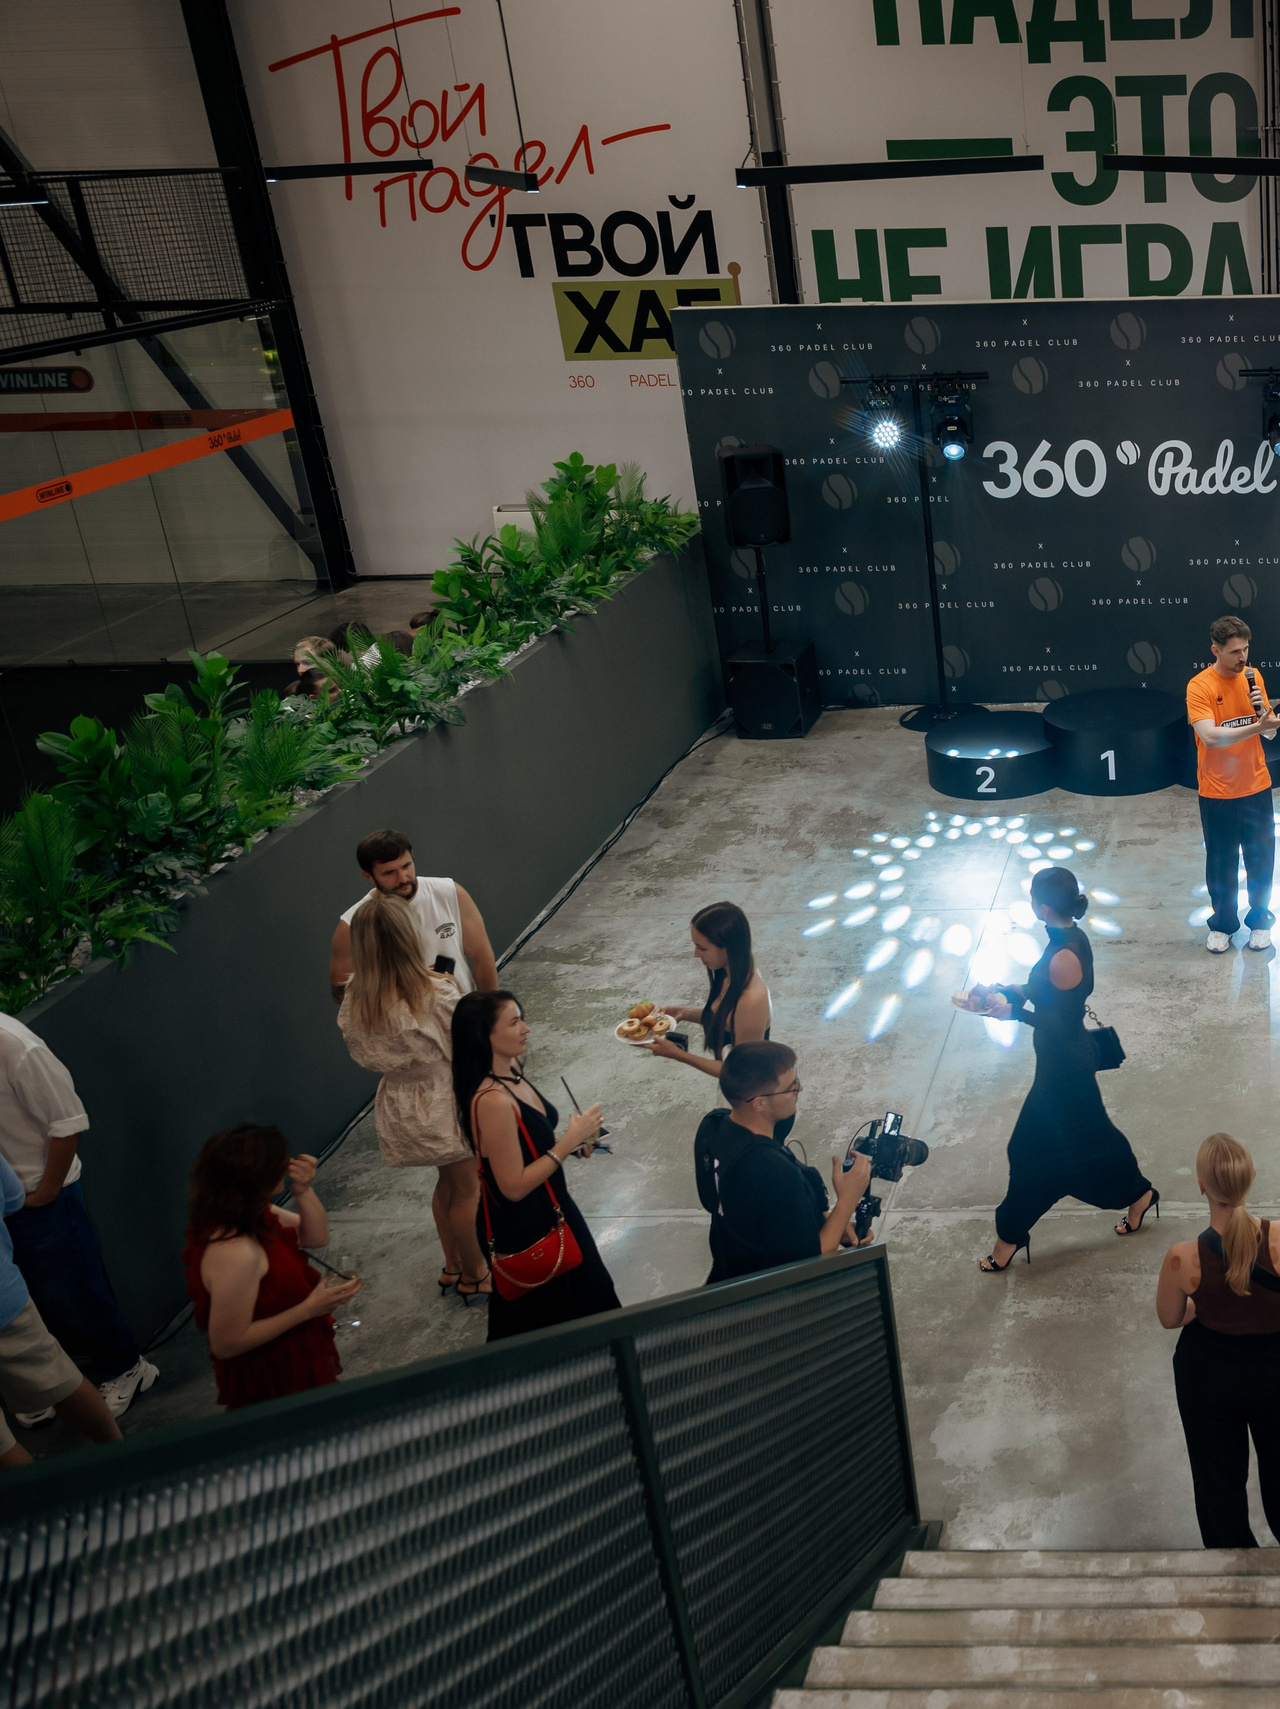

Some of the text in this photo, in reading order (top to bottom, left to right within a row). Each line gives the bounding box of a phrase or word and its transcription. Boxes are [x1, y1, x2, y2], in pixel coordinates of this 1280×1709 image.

[1046, 72, 1260, 206] ЭТО
[489, 194, 720, 278] ТВОЙ
[563, 288, 721, 354] ХА
[975, 338, 1078, 348] 360 PADEL CLUB
[1180, 336, 1202, 344] 360
[1209, 335, 1246, 343] PADEL
[770, 342, 873, 352] 360 PADEL CLUB
[568, 373, 677, 389] 360 PADEL
[1078, 378, 1180, 388] 360 PADEL CLUB
[700, 388, 737, 396] PADEL
[743, 387, 774, 395] CLUB
[784, 456, 885, 466] 360 PADEL CLUB
[1148, 438, 1277, 496] Padel
[39, 486, 65, 501] WINLINE
[886, 495, 949, 504] 360 PDEL
[993, 560, 1091, 570] 360 PADEL CLUB
[1189, 558, 1209, 566] 360
[1216, 557, 1251, 565] PADEL
[798, 564, 896, 574] 360 PADEL CLUB
[898, 600, 995, 610] 360 PDEL CLUB
[1091, 597, 1189, 606] 360 PADEL CLUB
[731, 605, 759, 613] PADE
[773, 604, 802, 612] CLUB
[838, 668, 872, 676] PADEL
[878, 667, 907, 675] CLUB
[1002, 663, 1098, 673] 360 PADEL CLUB
[1100, 749, 1117, 781] 1
[975, 766, 997, 793] 2
